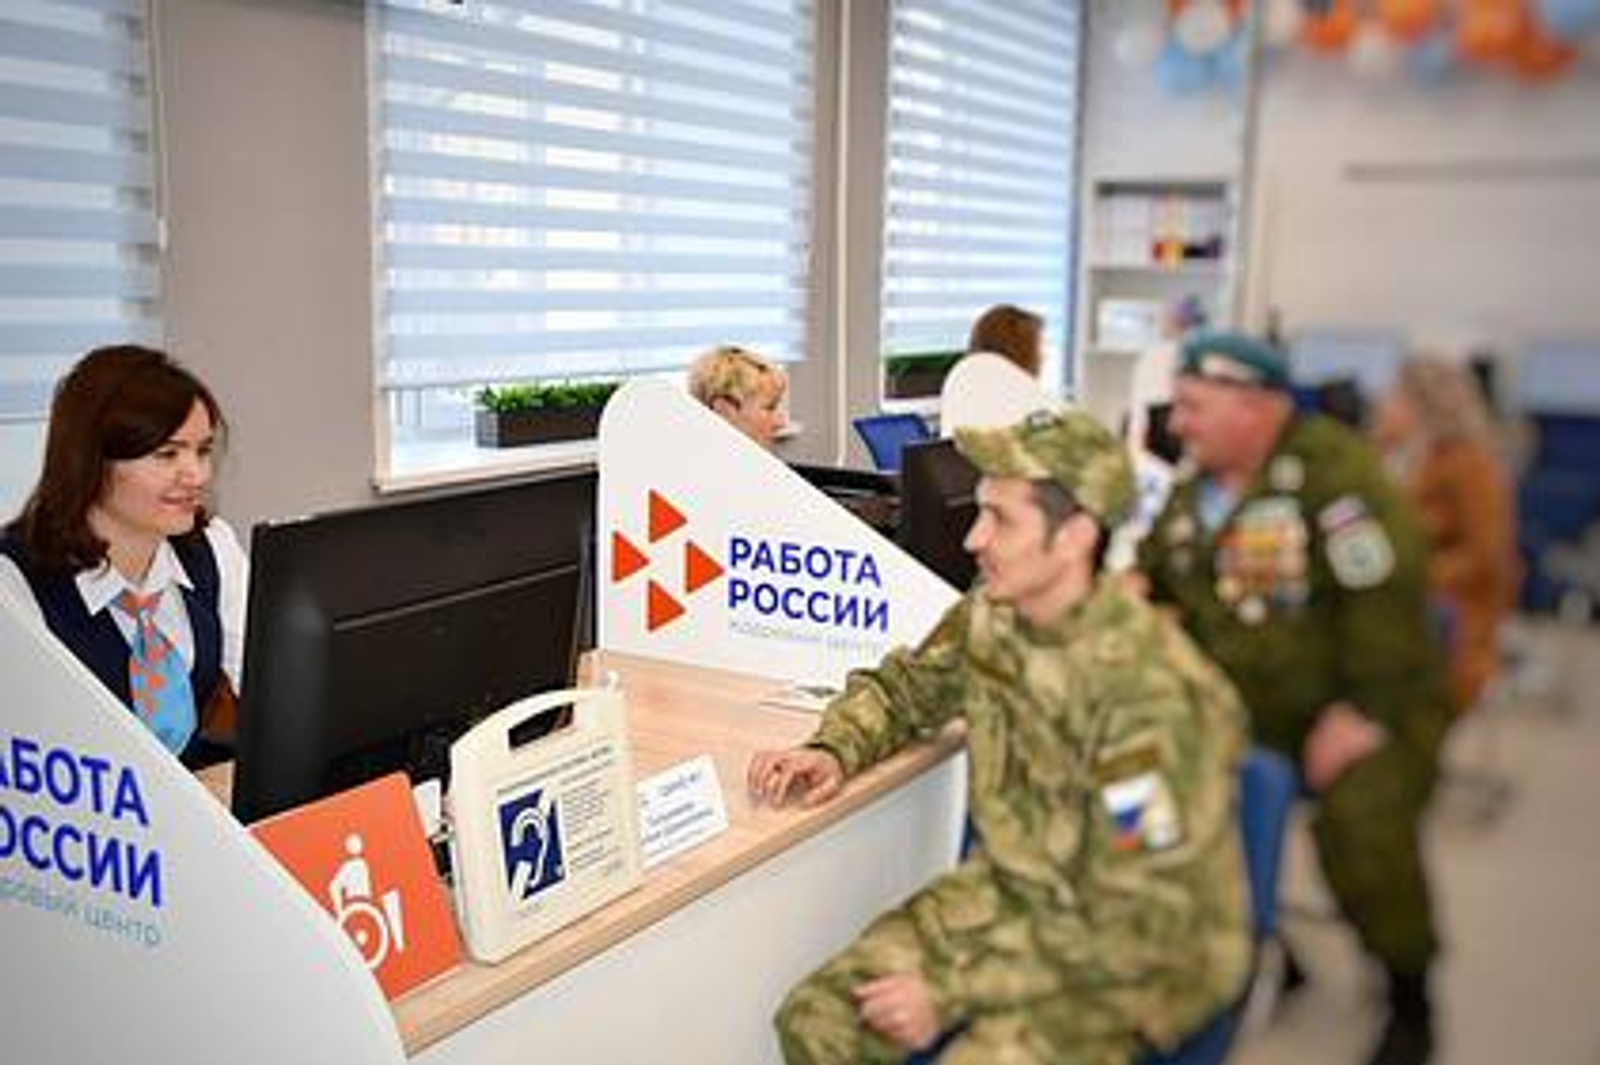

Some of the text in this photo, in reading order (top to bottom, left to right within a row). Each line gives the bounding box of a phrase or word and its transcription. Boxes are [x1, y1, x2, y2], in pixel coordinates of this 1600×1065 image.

[730, 537, 881, 587] РАБОТА
[728, 578, 889, 632] РОССИИ
[0, 737, 149, 827] БОТА
